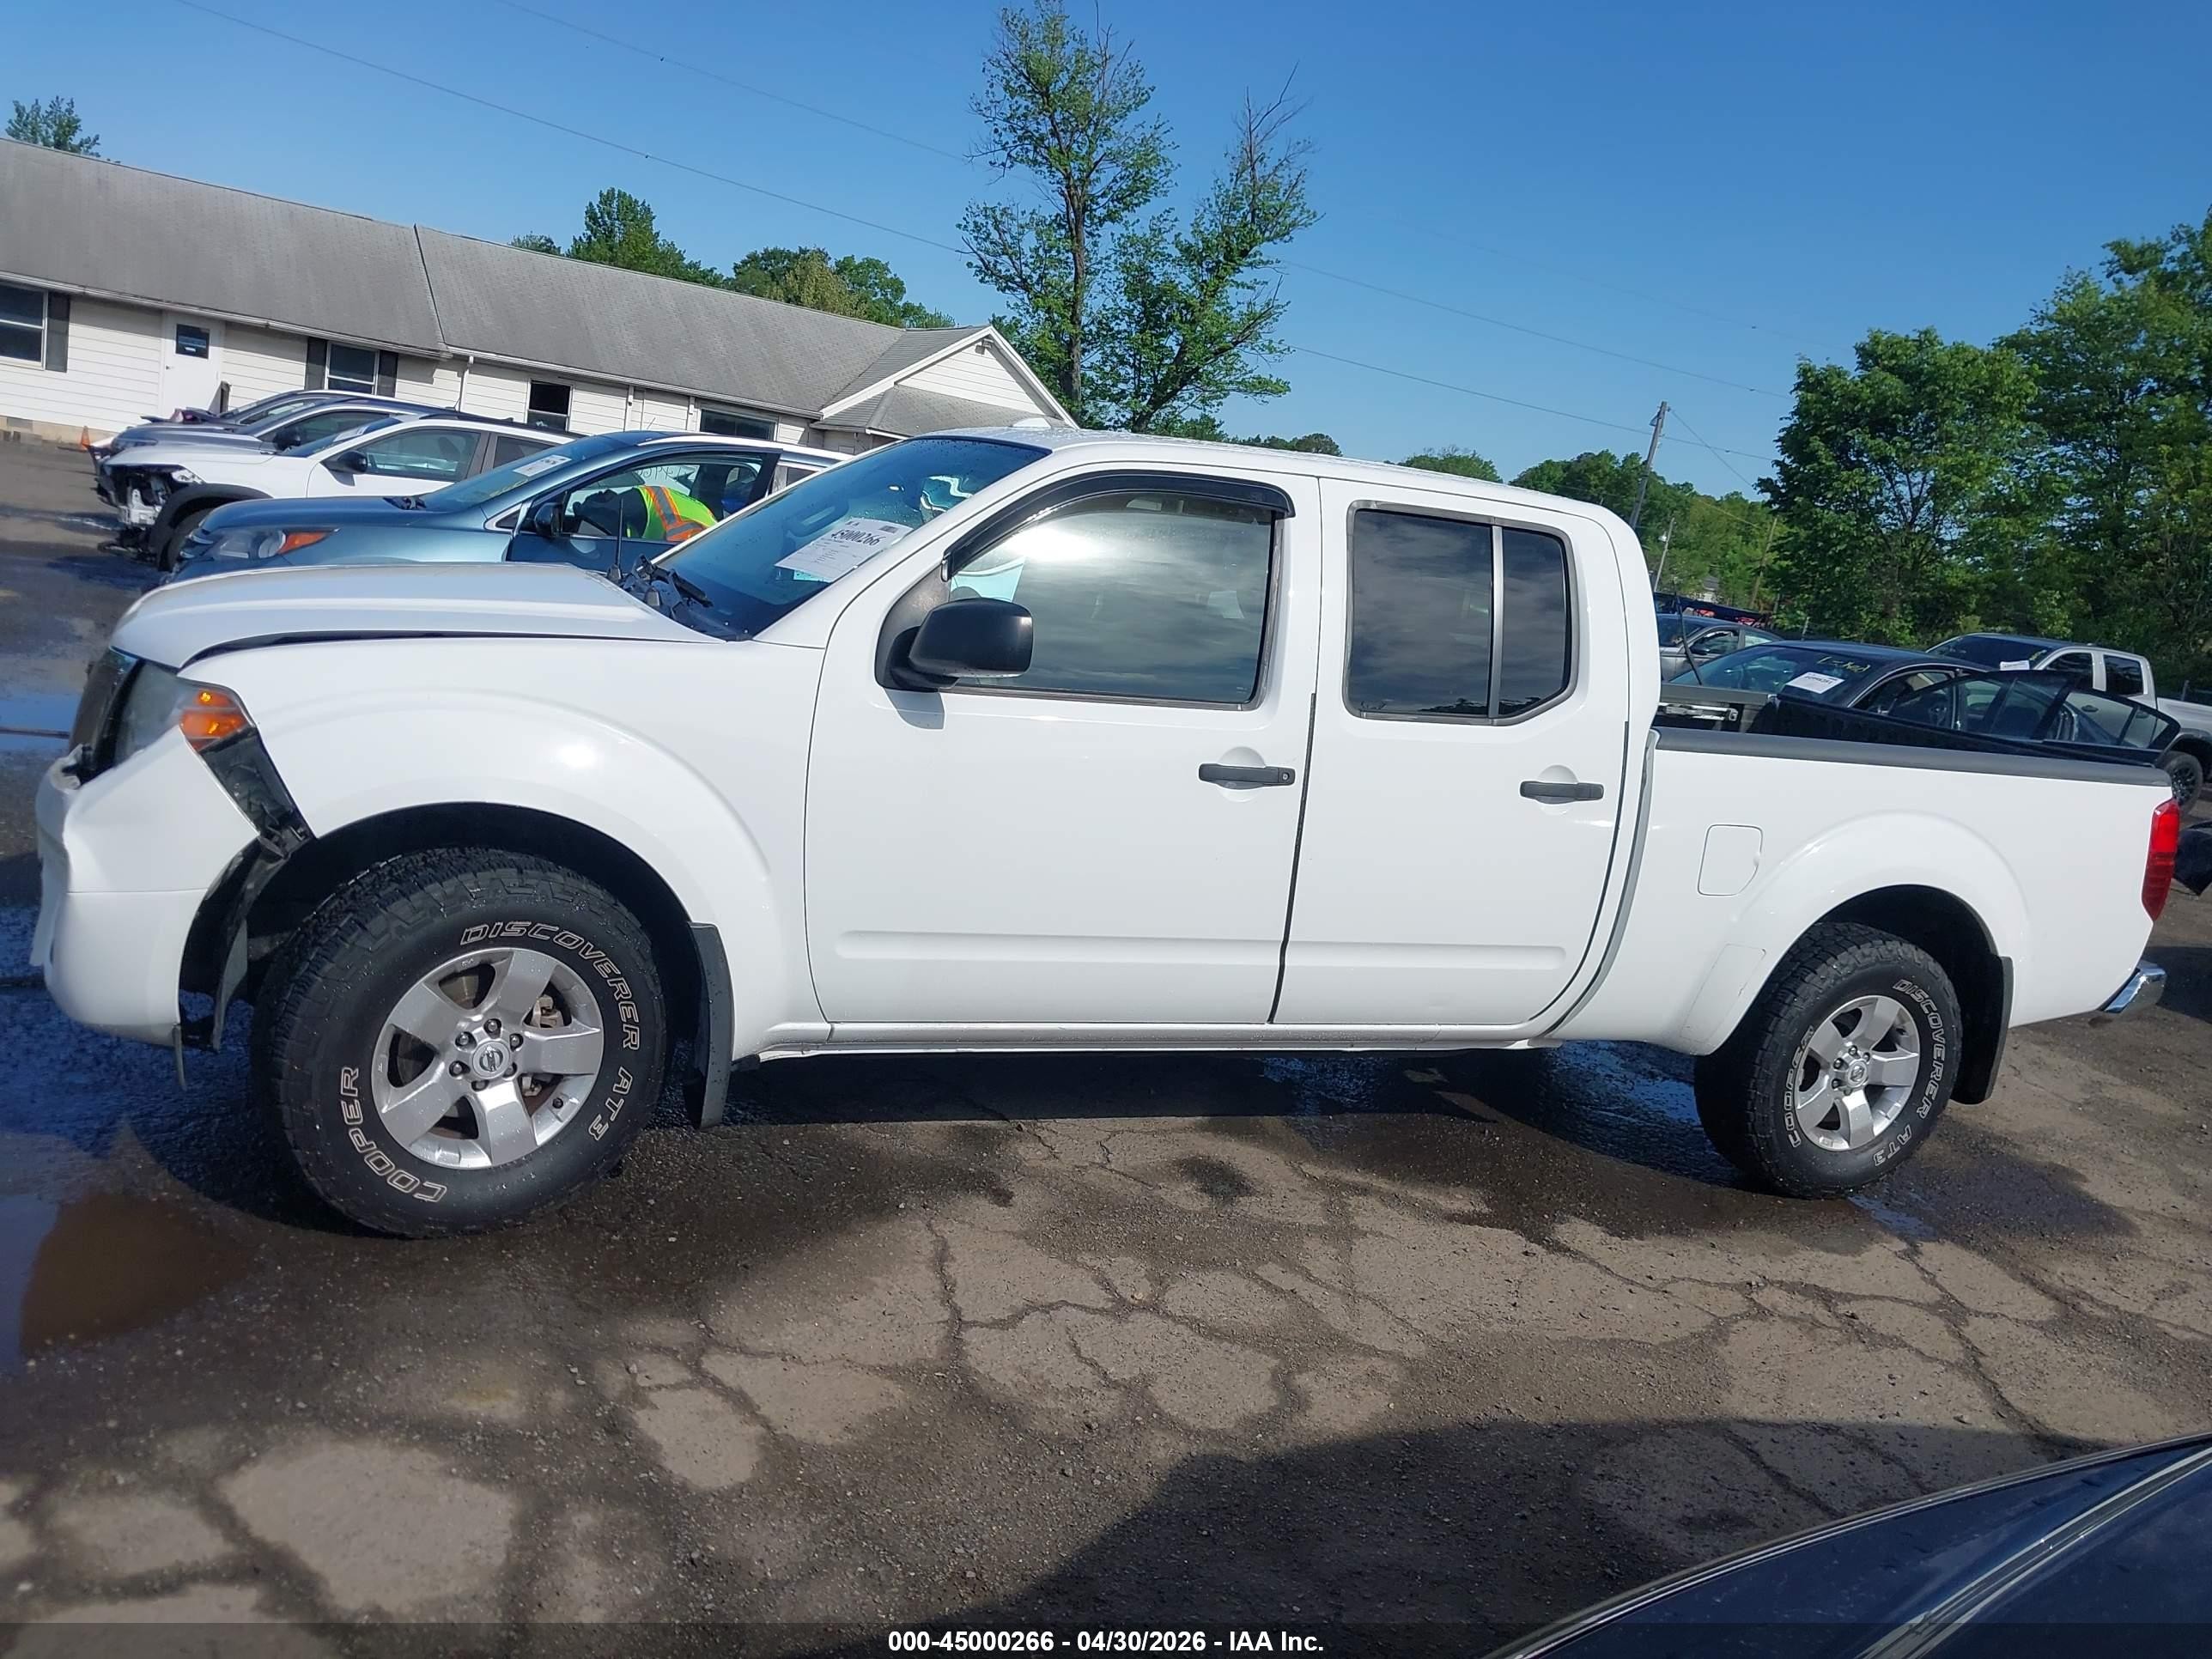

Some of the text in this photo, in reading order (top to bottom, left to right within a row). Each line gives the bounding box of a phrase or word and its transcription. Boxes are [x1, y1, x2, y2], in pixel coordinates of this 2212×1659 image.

[459, 921, 641, 1142] DISCOVERER AT3
[1872, 979, 1946, 1166] DISCOVERER AT3
[340, 1066, 448, 1204] COOPER
